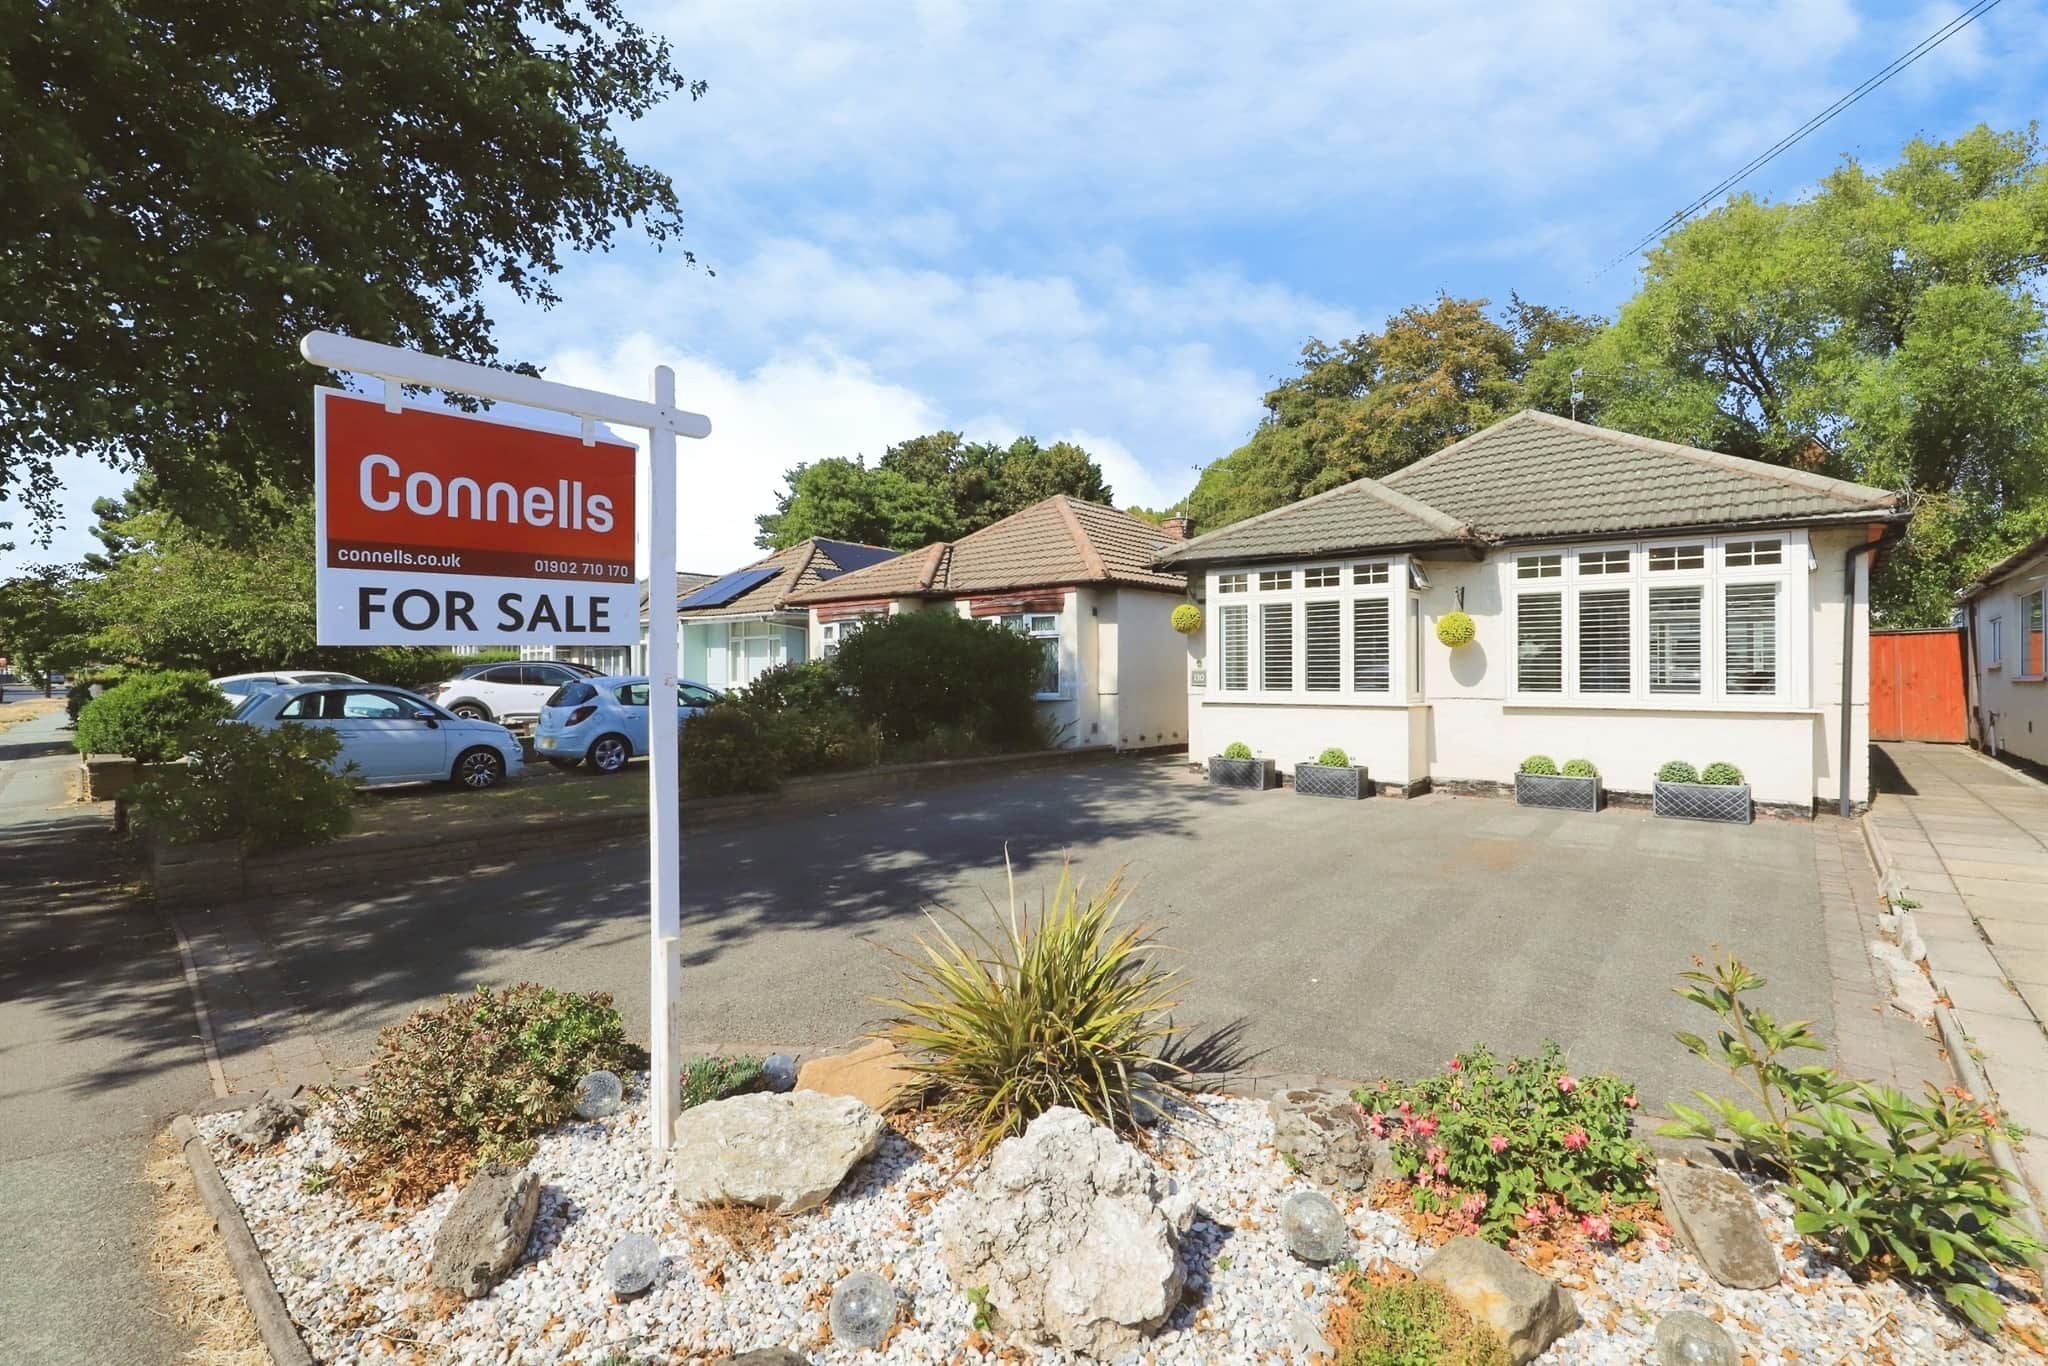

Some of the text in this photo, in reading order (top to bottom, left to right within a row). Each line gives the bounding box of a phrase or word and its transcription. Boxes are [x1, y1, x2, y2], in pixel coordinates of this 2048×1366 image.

[359, 454, 614, 533] Connells
[338, 549, 461, 568] connells.co.uk
[534, 559, 629, 577] 01902 710 170
[358, 587, 611, 633] FOR SALE
